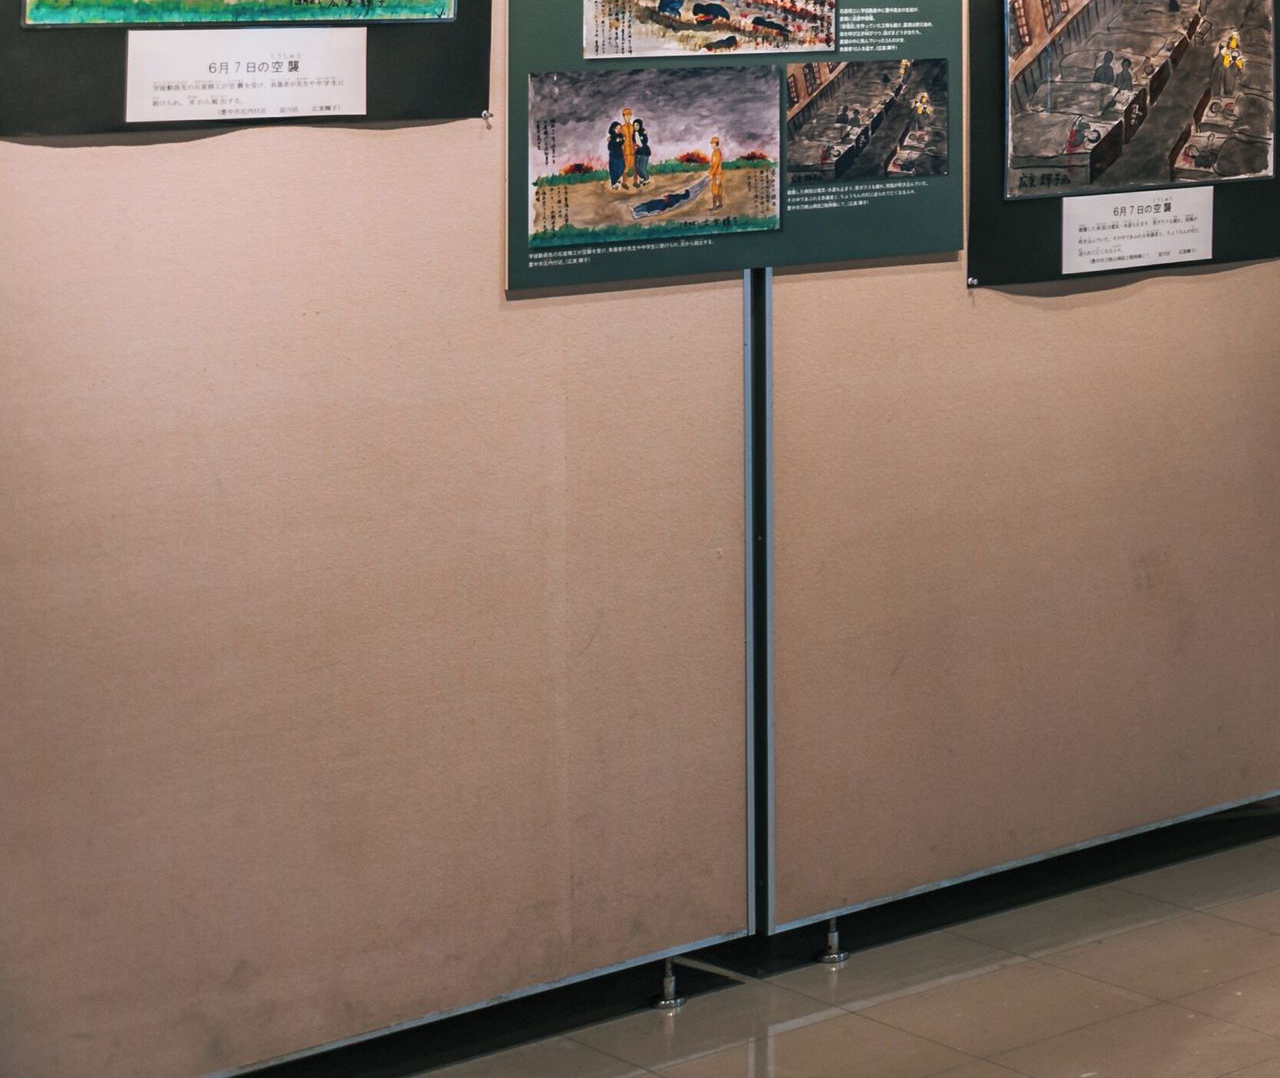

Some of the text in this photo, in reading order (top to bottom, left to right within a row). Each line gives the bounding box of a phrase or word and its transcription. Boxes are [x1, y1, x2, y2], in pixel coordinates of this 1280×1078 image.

[208, 60, 300, 74] 6月7日の空襲
